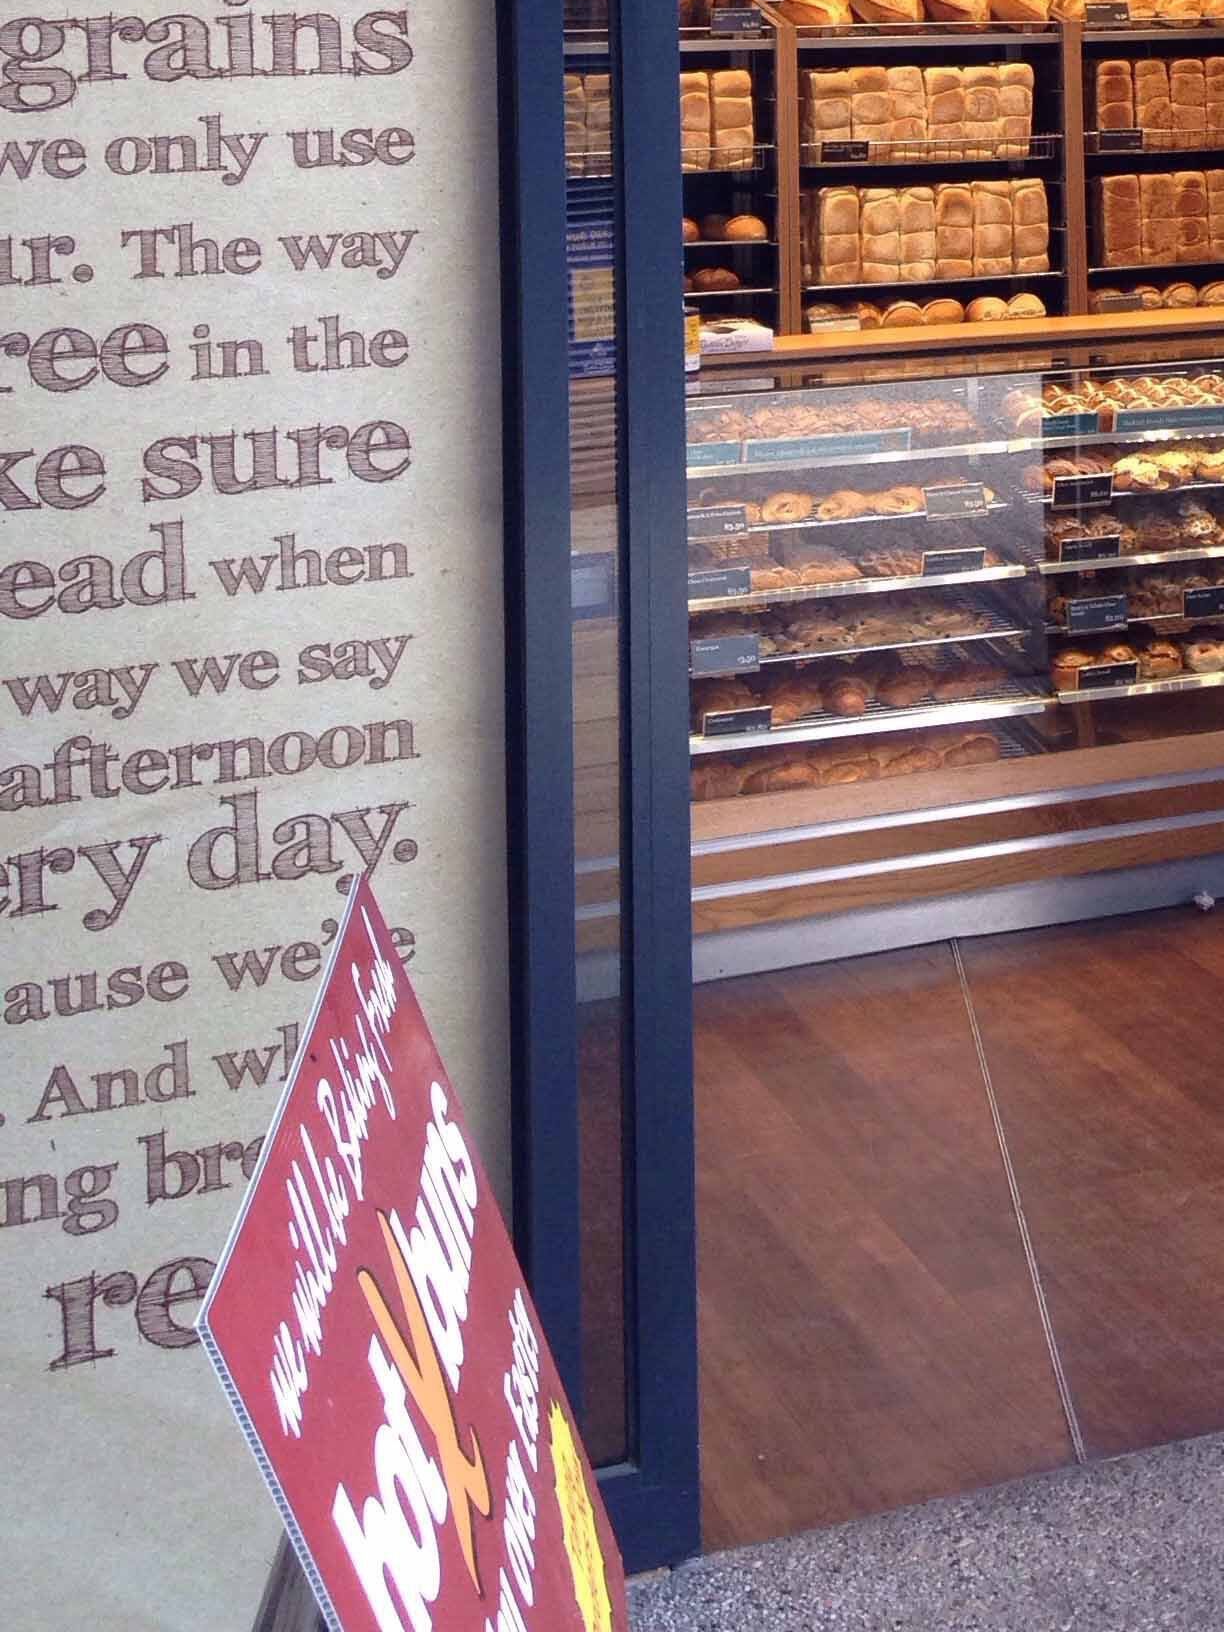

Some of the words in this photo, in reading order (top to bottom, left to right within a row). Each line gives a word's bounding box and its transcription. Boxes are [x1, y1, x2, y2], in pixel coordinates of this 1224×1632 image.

[104, 116, 268, 184] only
[286, 121, 416, 168] use
[121, 223, 262, 279] The
[277, 226, 419, 279] way
[189, 324, 270, 382] in
[287, 315, 410, 373] the
[142, 419, 413, 505] sure
[209, 534, 415, 598] when
[3, 663, 159, 719] way
[172, 646, 281, 698] we
[297, 634, 415, 689] say
[0, 716, 421, 812] afternoon
[187, 787, 419, 896] day.
[212, 918, 416, 992] we'e
[26, 1040, 197, 1125] And
[301, 1124, 348, 1246] be
[288, 1159, 338, 1356] will
[270, 1321, 309, 1439] we
[332, 1333, 448, 1632] hot
[390, 1081, 477, 1394] buns
[503, 1287, 539, 1473] Easter
[503, 1439, 537, 1608] over
